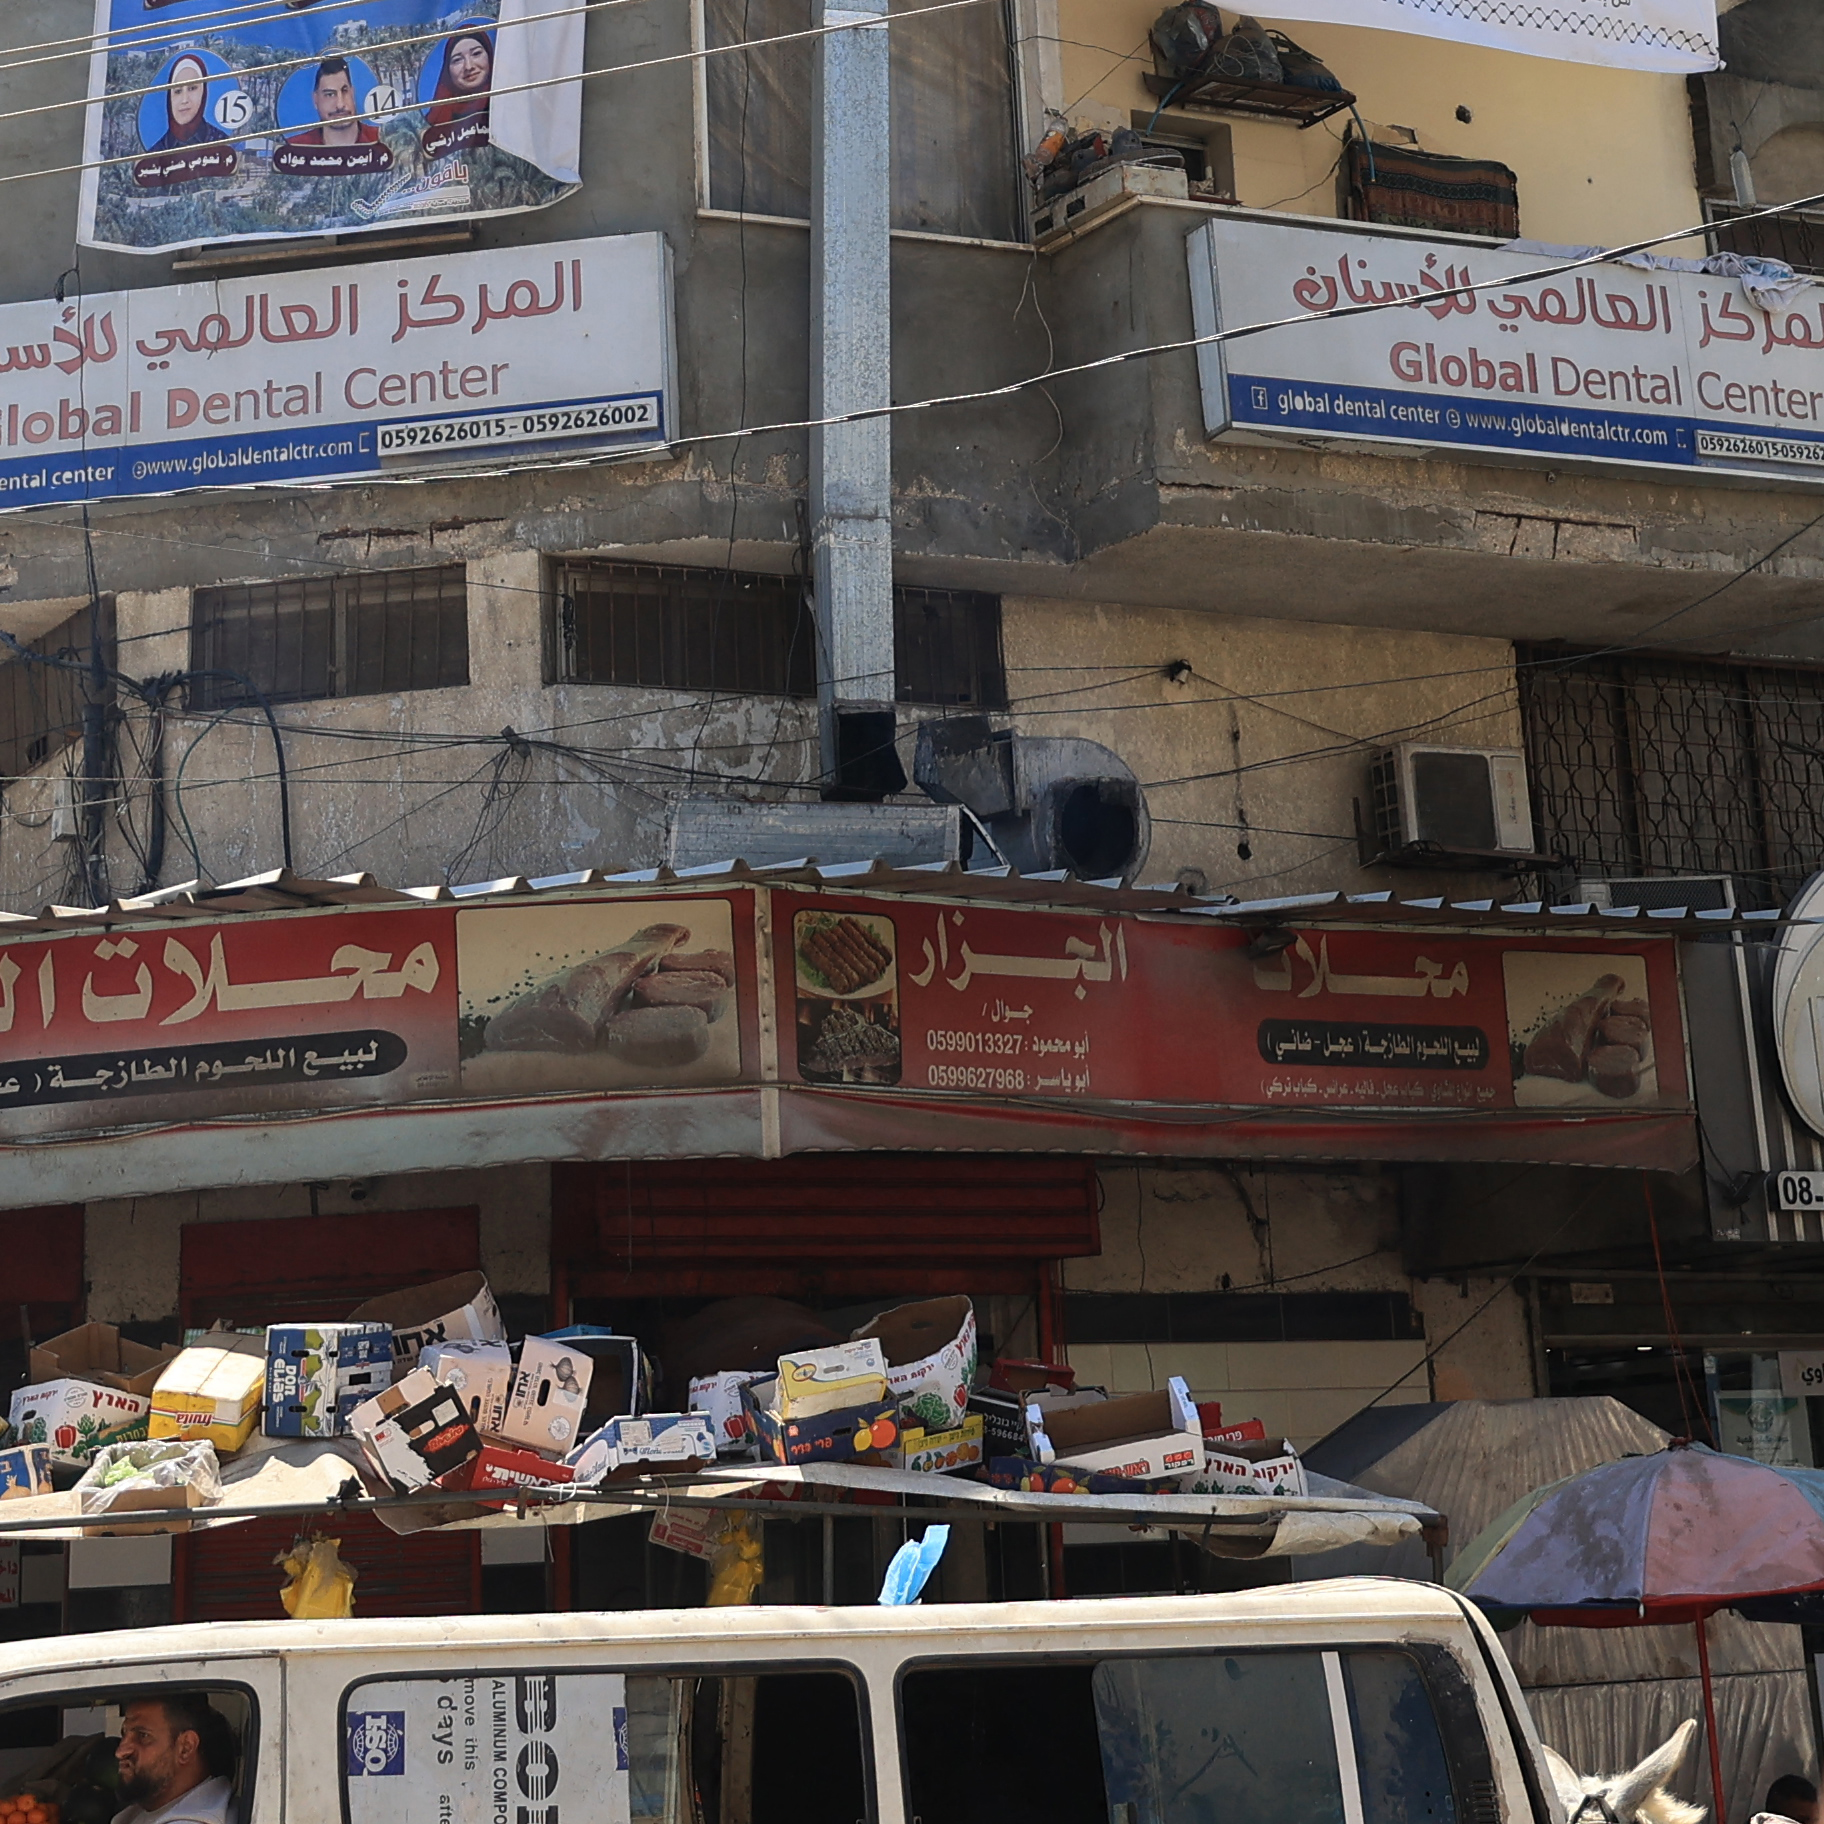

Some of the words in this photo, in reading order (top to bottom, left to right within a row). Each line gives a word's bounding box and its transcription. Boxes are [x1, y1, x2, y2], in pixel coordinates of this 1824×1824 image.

[219, 95, 249, 124] 15
[280, 153, 306, 166] عواد
[309, 155, 342, 166] محمد
[346, 149, 373, 167] أيمن
[391, 258, 582, 344] المركز
[1293, 252, 1477, 321] للأسنان
[1487, 276, 1672, 333] العالمي
[135, 283, 358, 371] العالمي
[167, 371, 323, 430] Dental
[344, 360, 510, 410] Center
[1389, 341, 1539, 394] Global
[1550, 356, 1682, 406] Dental
[1697, 371, 1824, 421] Center
[1278, 391, 1330, 416] global
[1333, 395, 1387, 419] dental
[1389, 403, 1440, 425] center
[380, 418, 505, 450] 0592626015
[522, 404, 650, 434] 0592626002
[1466, 412, 1668, 446] www.globaldentalctr.com
[51, 465, 115, 487] center
[908, 909, 1128, 1000] الجزار
[81, 931, 440, 1027] محلات
[991, 998, 1034, 1025] جوال
[303, 1039, 380, 1075] لبيع
[927, 1029, 1023, 1055] 0599013327
[1275, 1028, 1312, 1061] ضاني
[1323, 1031, 1354, 1058] عجل
[1364, 1030, 1415, 1060] الطازجة
[1416, 1035, 1452, 1061] اللحوم
[1454, 1037, 1480, 1065] لبيع
[47, 1057, 188, 1092] الطازجة
[193, 1042, 295, 1082] اللحوم
[928, 1064, 1025, 1090] 0599627968
[92, 1389, 141, 1414] הארץ
[431, 1694, 458, 1766] days
[491, 1679, 508, 1763] ALUMINUM
[364, 1714, 388, 1773] ISO
[464, 1738, 478, 1771] this
